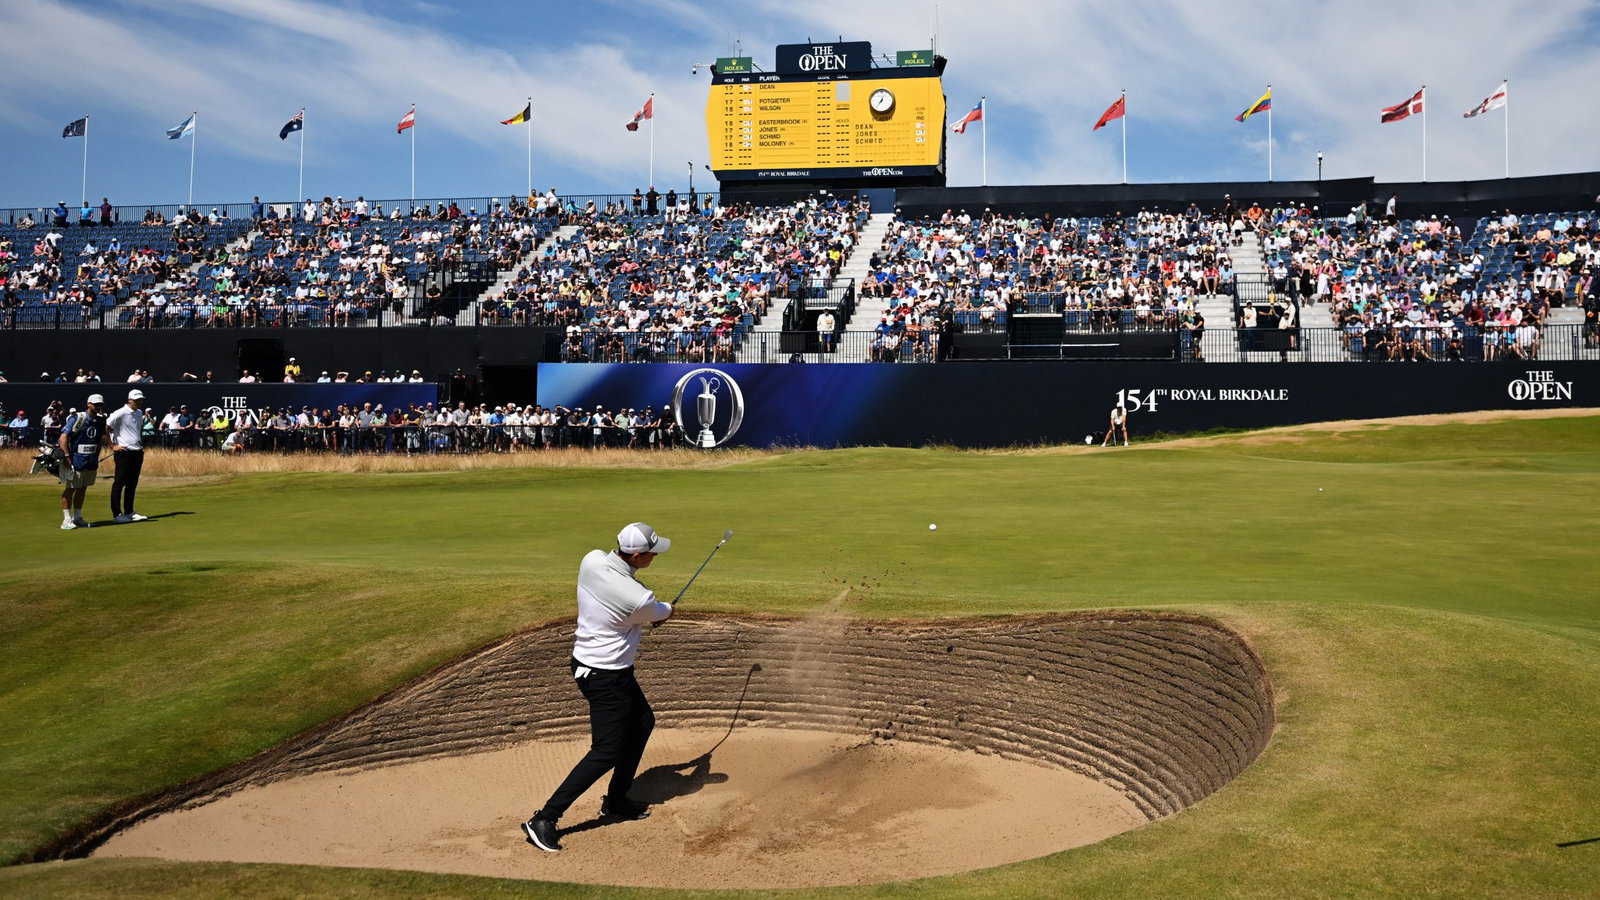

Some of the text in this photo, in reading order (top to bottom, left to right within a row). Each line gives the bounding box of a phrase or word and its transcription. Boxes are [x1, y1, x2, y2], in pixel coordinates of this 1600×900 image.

[813, 46, 833, 55] THE
[799, 54, 847, 71] OPEN
[1526, 371, 1554, 381] THE
[1171, 389, 1216, 400] ROYAL
[1219, 389, 1288, 400] BIRKDALE
[1508, 380, 1573, 400] OPEN
[222, 396, 247, 408] THE
